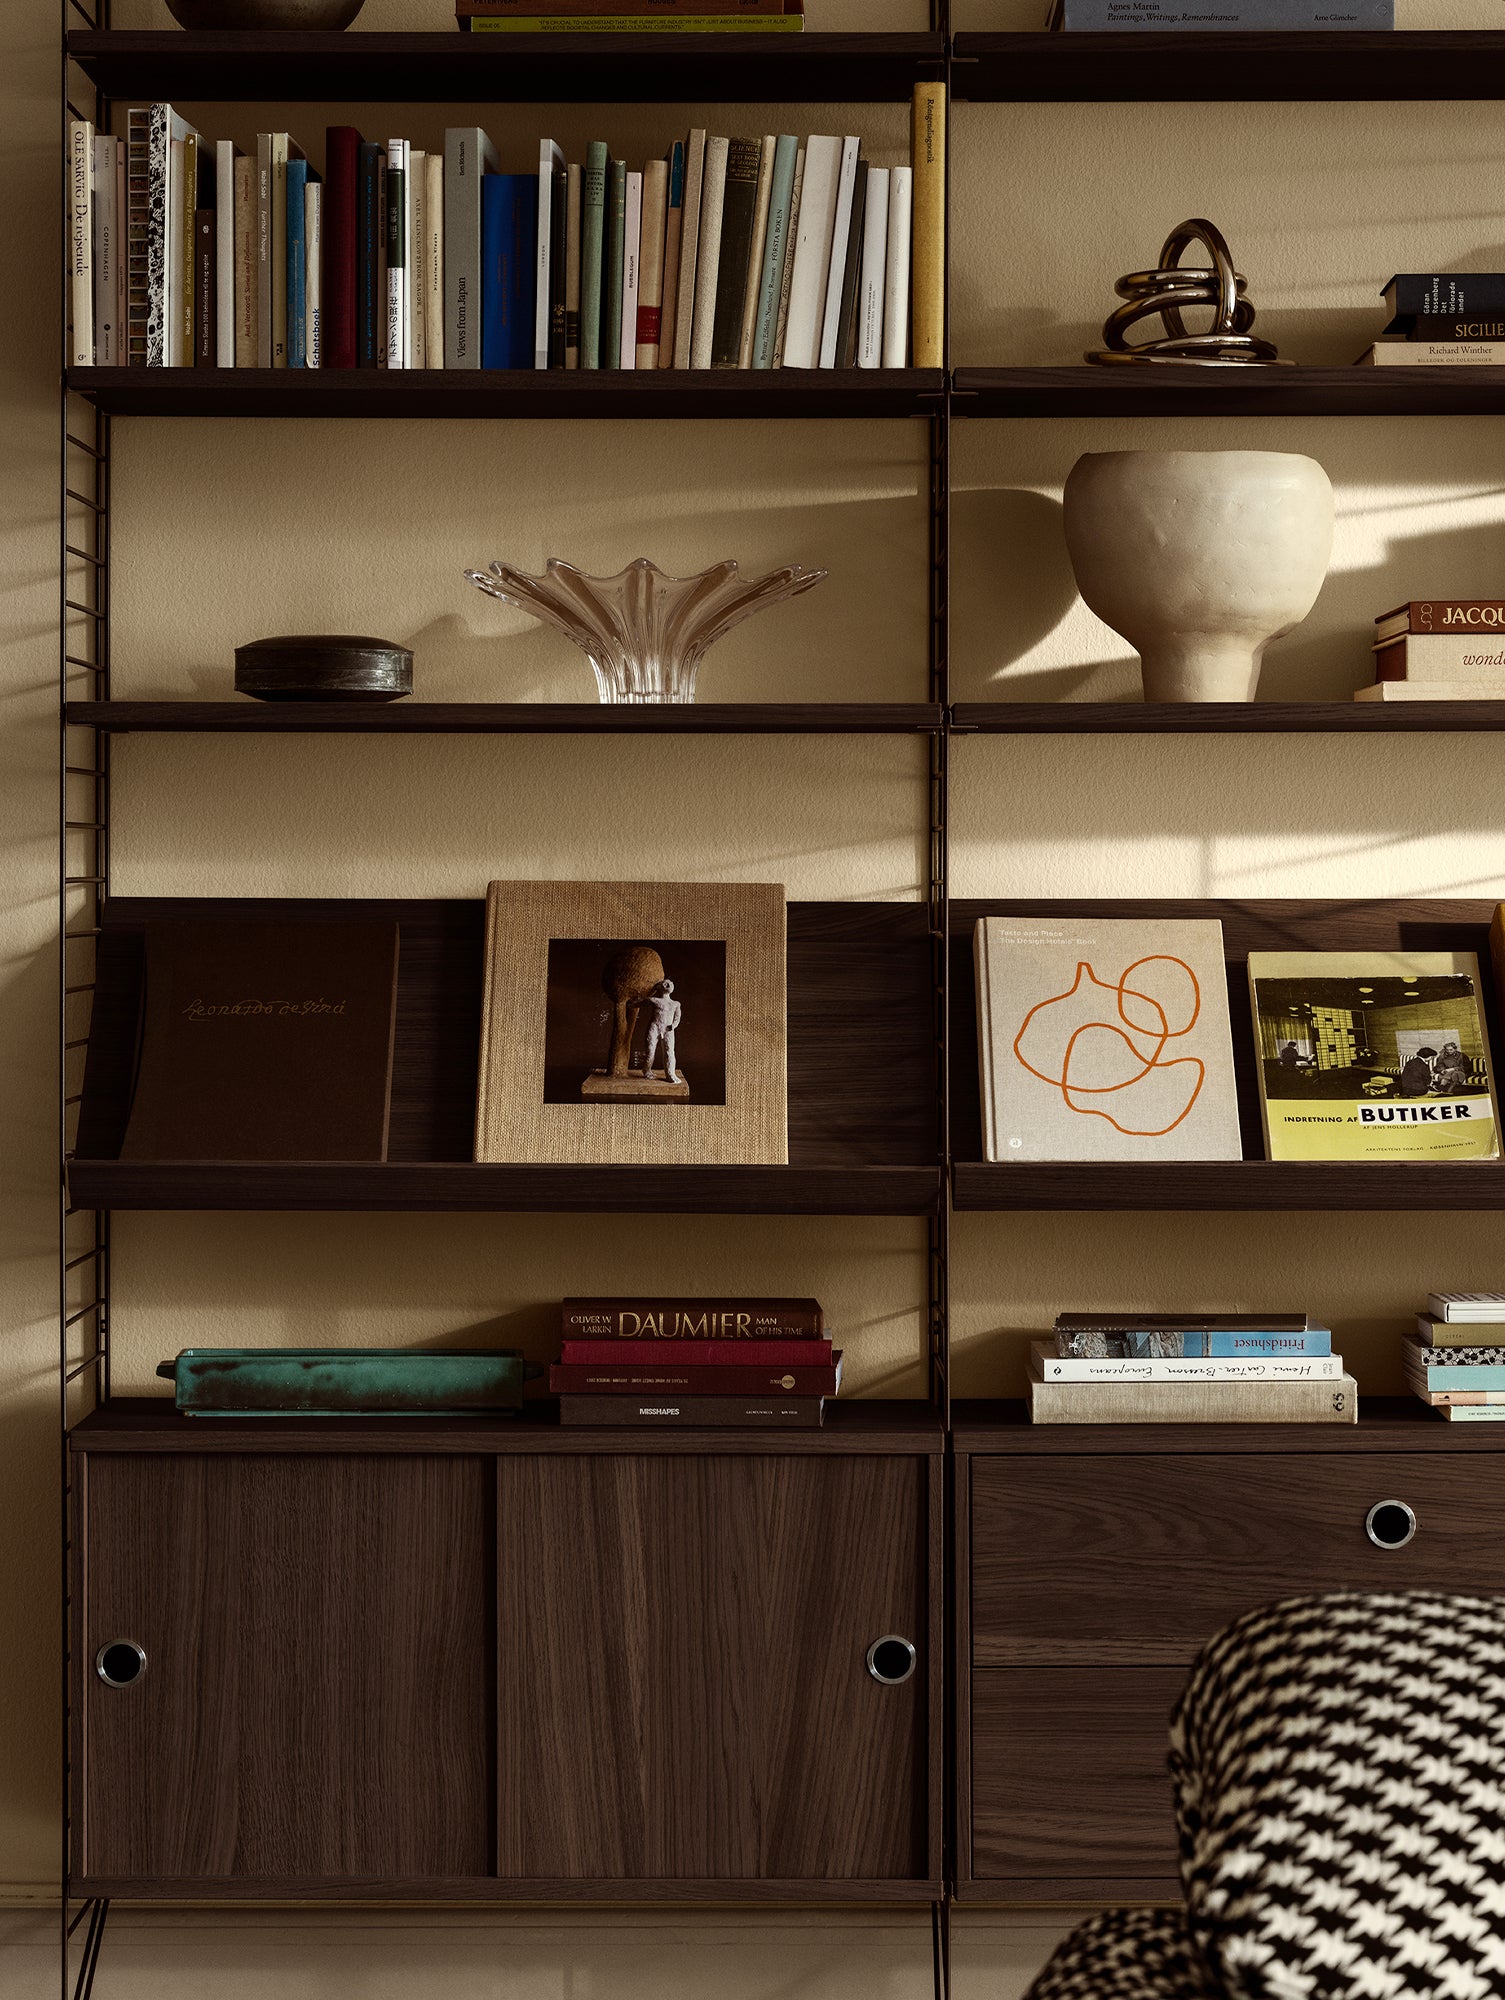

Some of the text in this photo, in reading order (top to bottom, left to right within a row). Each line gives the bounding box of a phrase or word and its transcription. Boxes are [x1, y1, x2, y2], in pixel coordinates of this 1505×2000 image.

[1108, 2, 1160, 11] Agnes Martin
[1107, 12, 1239, 22] Paintings, Writings, Remembrances
[926, 98, 935, 164] Röntgendiagnostik
[74, 131, 88, 276] OLE SARVIG De rejsende
[774, 208, 783, 233] BOKEN
[771, 234, 780, 261] FÖRSTA
[1432, 277, 1440, 314] Rosenberg
[456, 277, 468, 358] Views from Japan
[388, 296, 398, 357] デザインの現在
[1455, 322, 1505, 338] SICILIE
[312, 308, 320, 366] Schetsboek
[1429, 346, 1492, 354] Richard Winther
[1462, 651, 1505, 666] wond
[1360, 1104, 1472, 1122] BUTIKER
[570, 1316, 600, 1324] OLIVER
[618, 1312, 753, 1338] DAUMIER
[755, 1317, 777, 1325] MAN
[582, 1326, 612, 1334] LARKIN
[755, 1327, 803, 1336] OF HIS TIME
[1234, 1338, 1305, 1350] Fritidshuset
[1089, 1365, 1152, 1378] Europeans
[1273, 1365, 1311, 1376] Henri
[1332, 1392, 1344, 1412] 65
[639, 1407, 680, 1416] MISSHAPES
